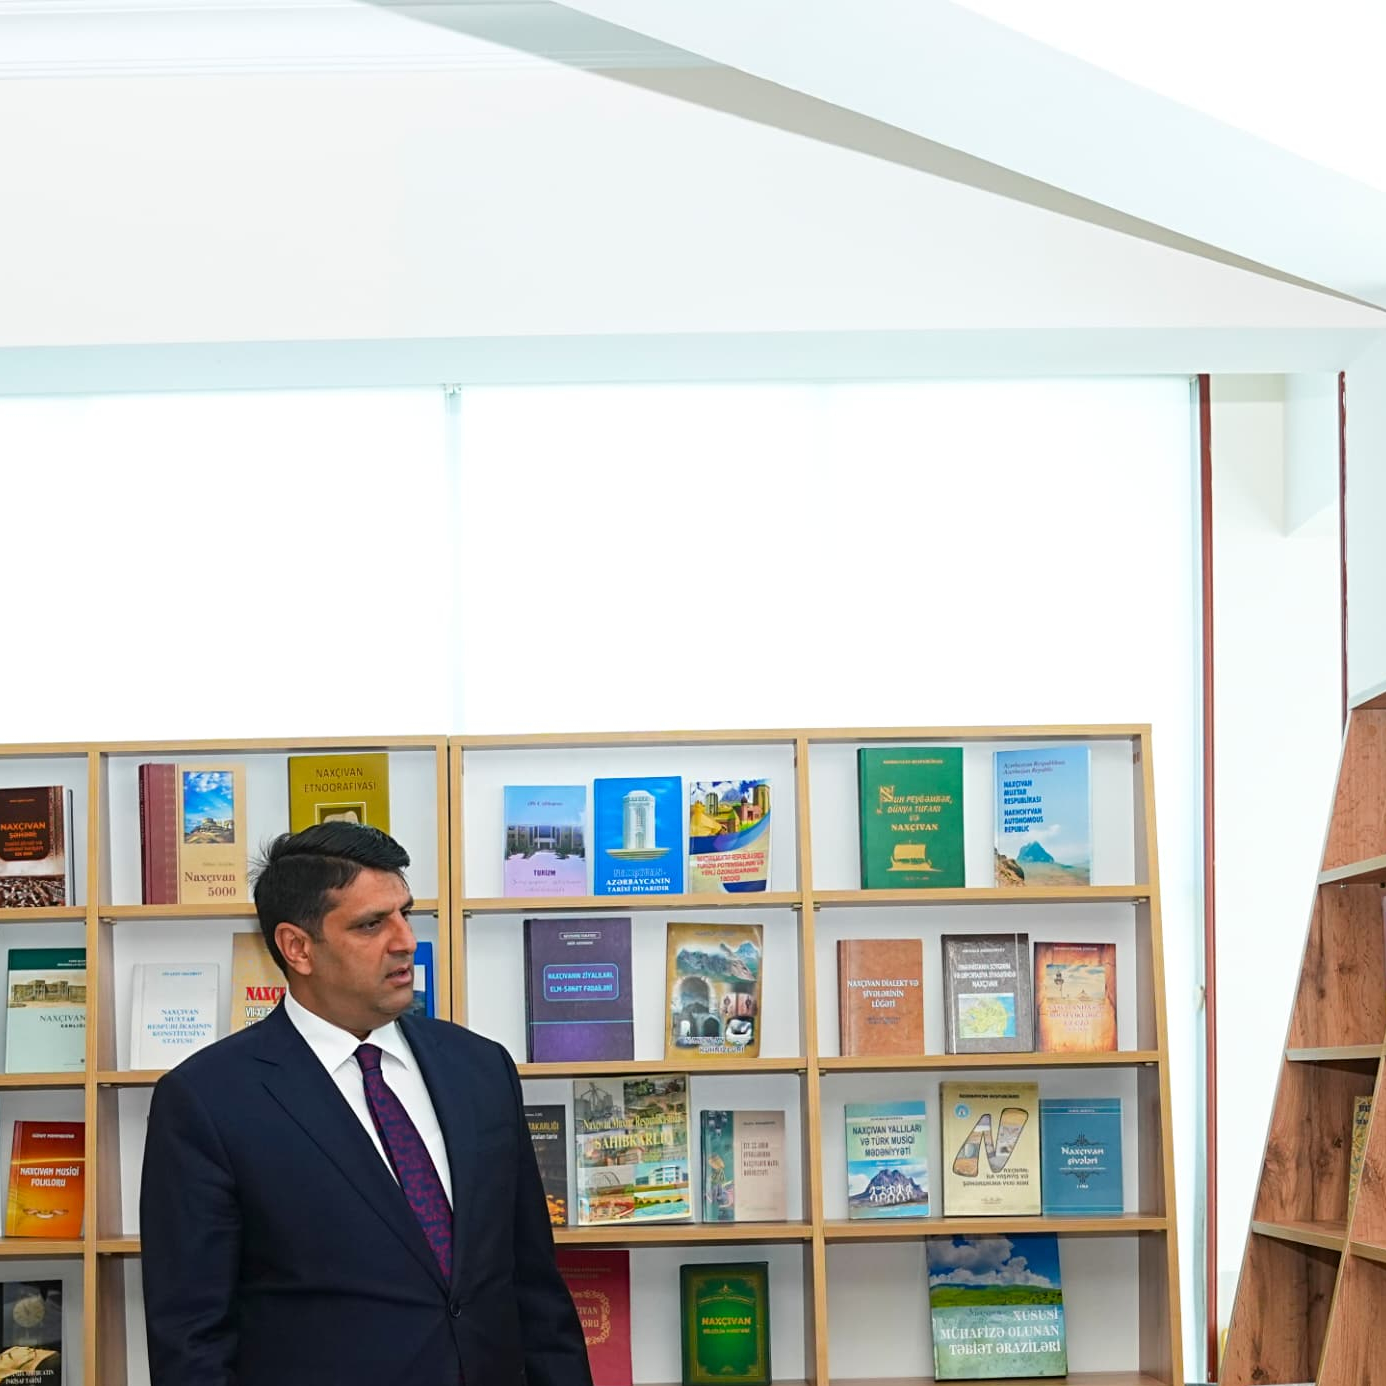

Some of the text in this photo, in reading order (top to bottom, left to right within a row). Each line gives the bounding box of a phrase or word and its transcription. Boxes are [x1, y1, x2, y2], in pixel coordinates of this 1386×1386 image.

[316, 768, 364, 779] NAXÇIVAN
[304, 781, 376, 793] ETNOQRAFİYASI
[0, 822, 45, 832] NAXÇIVAN
[891, 823, 938, 832] NAXÇIVAN
[184, 872, 236, 883] Naxçıvan
[207, 886, 236, 897] 5000
[847, 979, 919, 989] NAXÇIVAN DİALEKT VƏ
[245, 986, 286, 1004] NAXÇI
[852, 1124, 922, 1135] NAXÇIVAN YALLILARI
[860, 1137, 871, 1145] VƏ
[872, 1135, 889, 1145] TÜRK
[1061, 1146, 1104, 1157] Naxçıvan
[1067, 1157, 1098, 1166] şivələri
[20, 1167, 54, 1177] NAXÇIVAN
[31, 1178, 66, 1187] FOLKLORU
[701, 1317, 752, 1327] NAXÇIVAN
[940, 1325, 1059, 1339] MÜHAFİZƏ OLUNAN
[949, 1339, 1061, 1356] TƏBİƏT ƏRAZİLƏRİ
